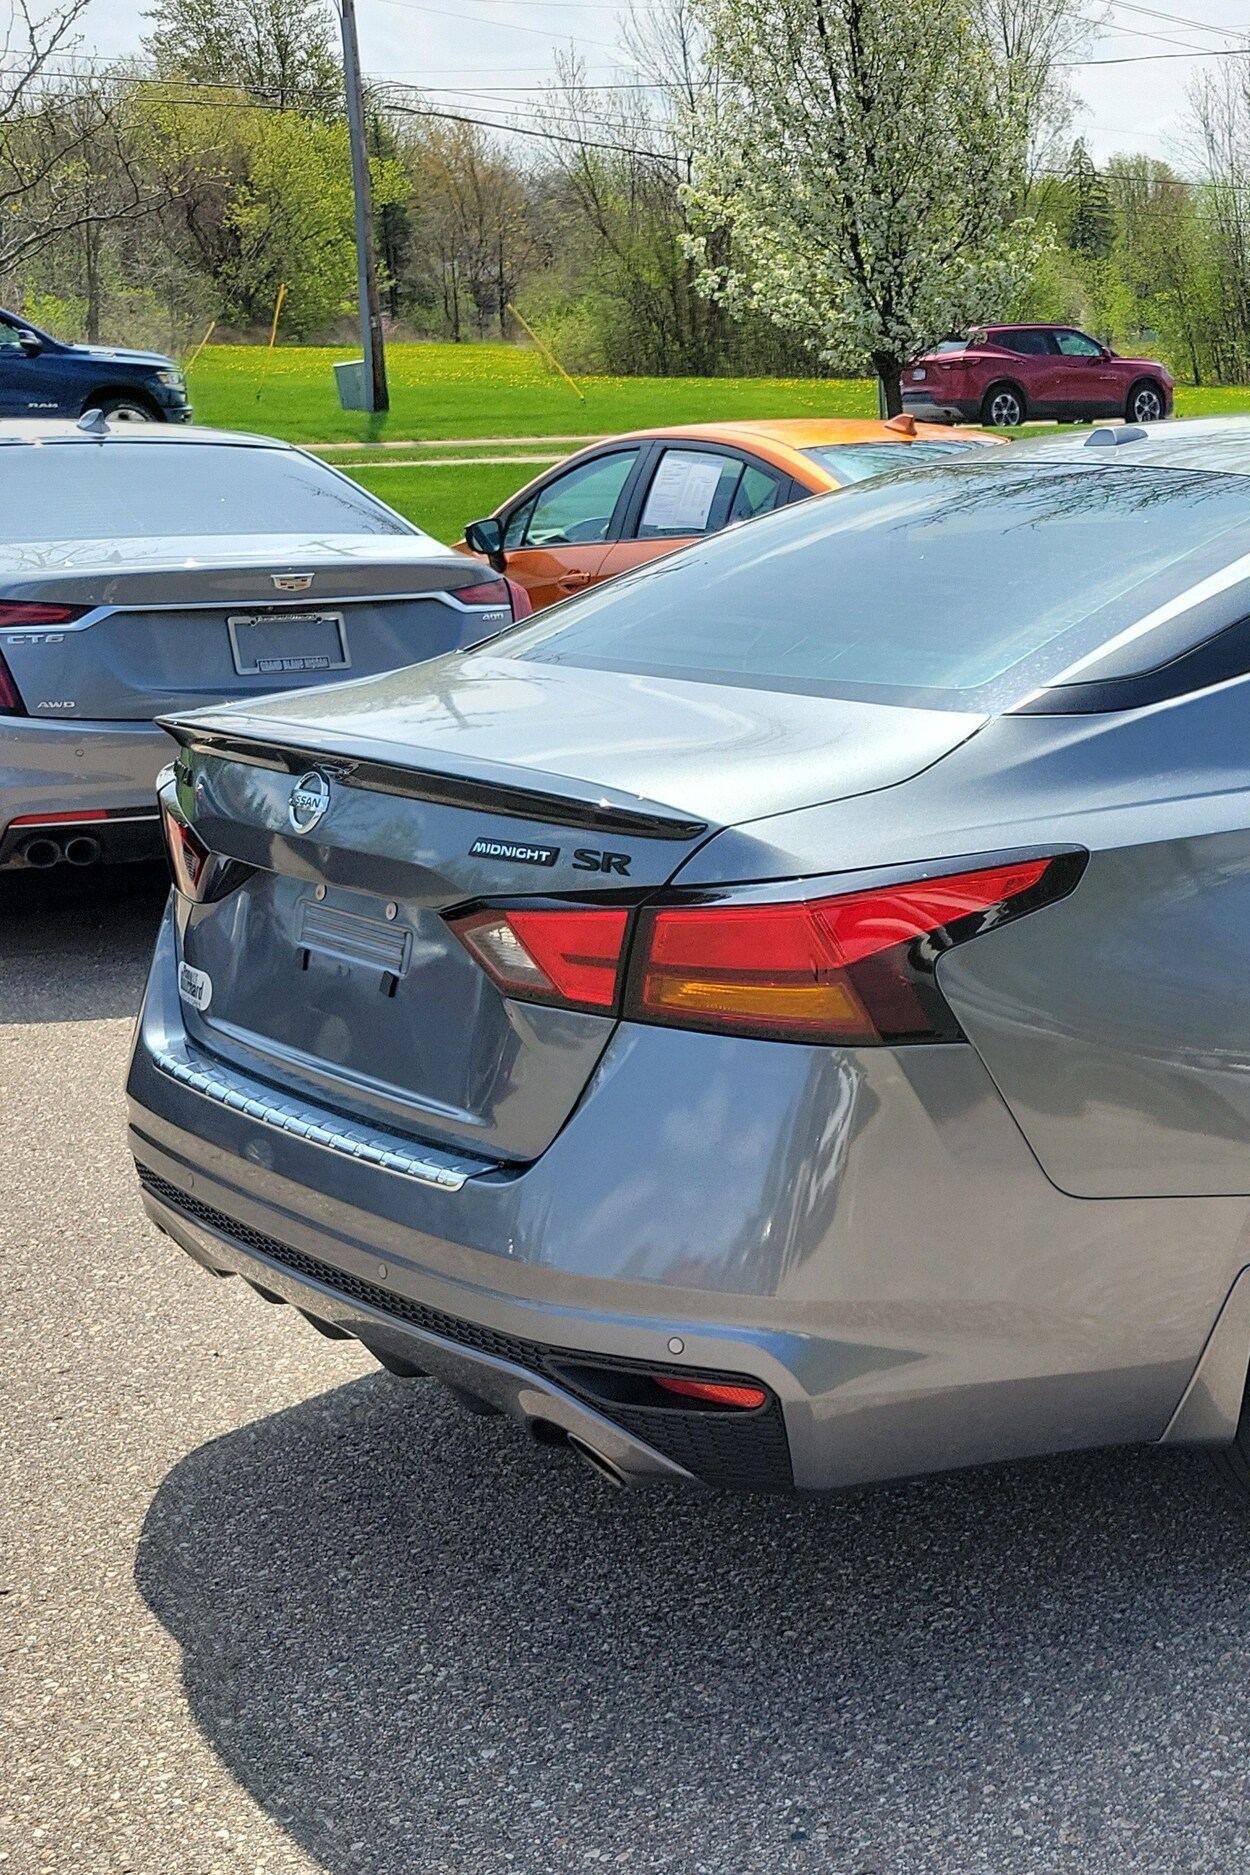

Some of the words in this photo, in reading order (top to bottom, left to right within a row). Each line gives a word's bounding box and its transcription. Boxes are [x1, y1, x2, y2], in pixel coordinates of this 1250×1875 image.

[7, 634, 64, 645] CT6
[290, 794, 321, 808] SSAN
[472, 841, 551, 862] MIDNIGHT
[571, 848, 632, 876] SR
